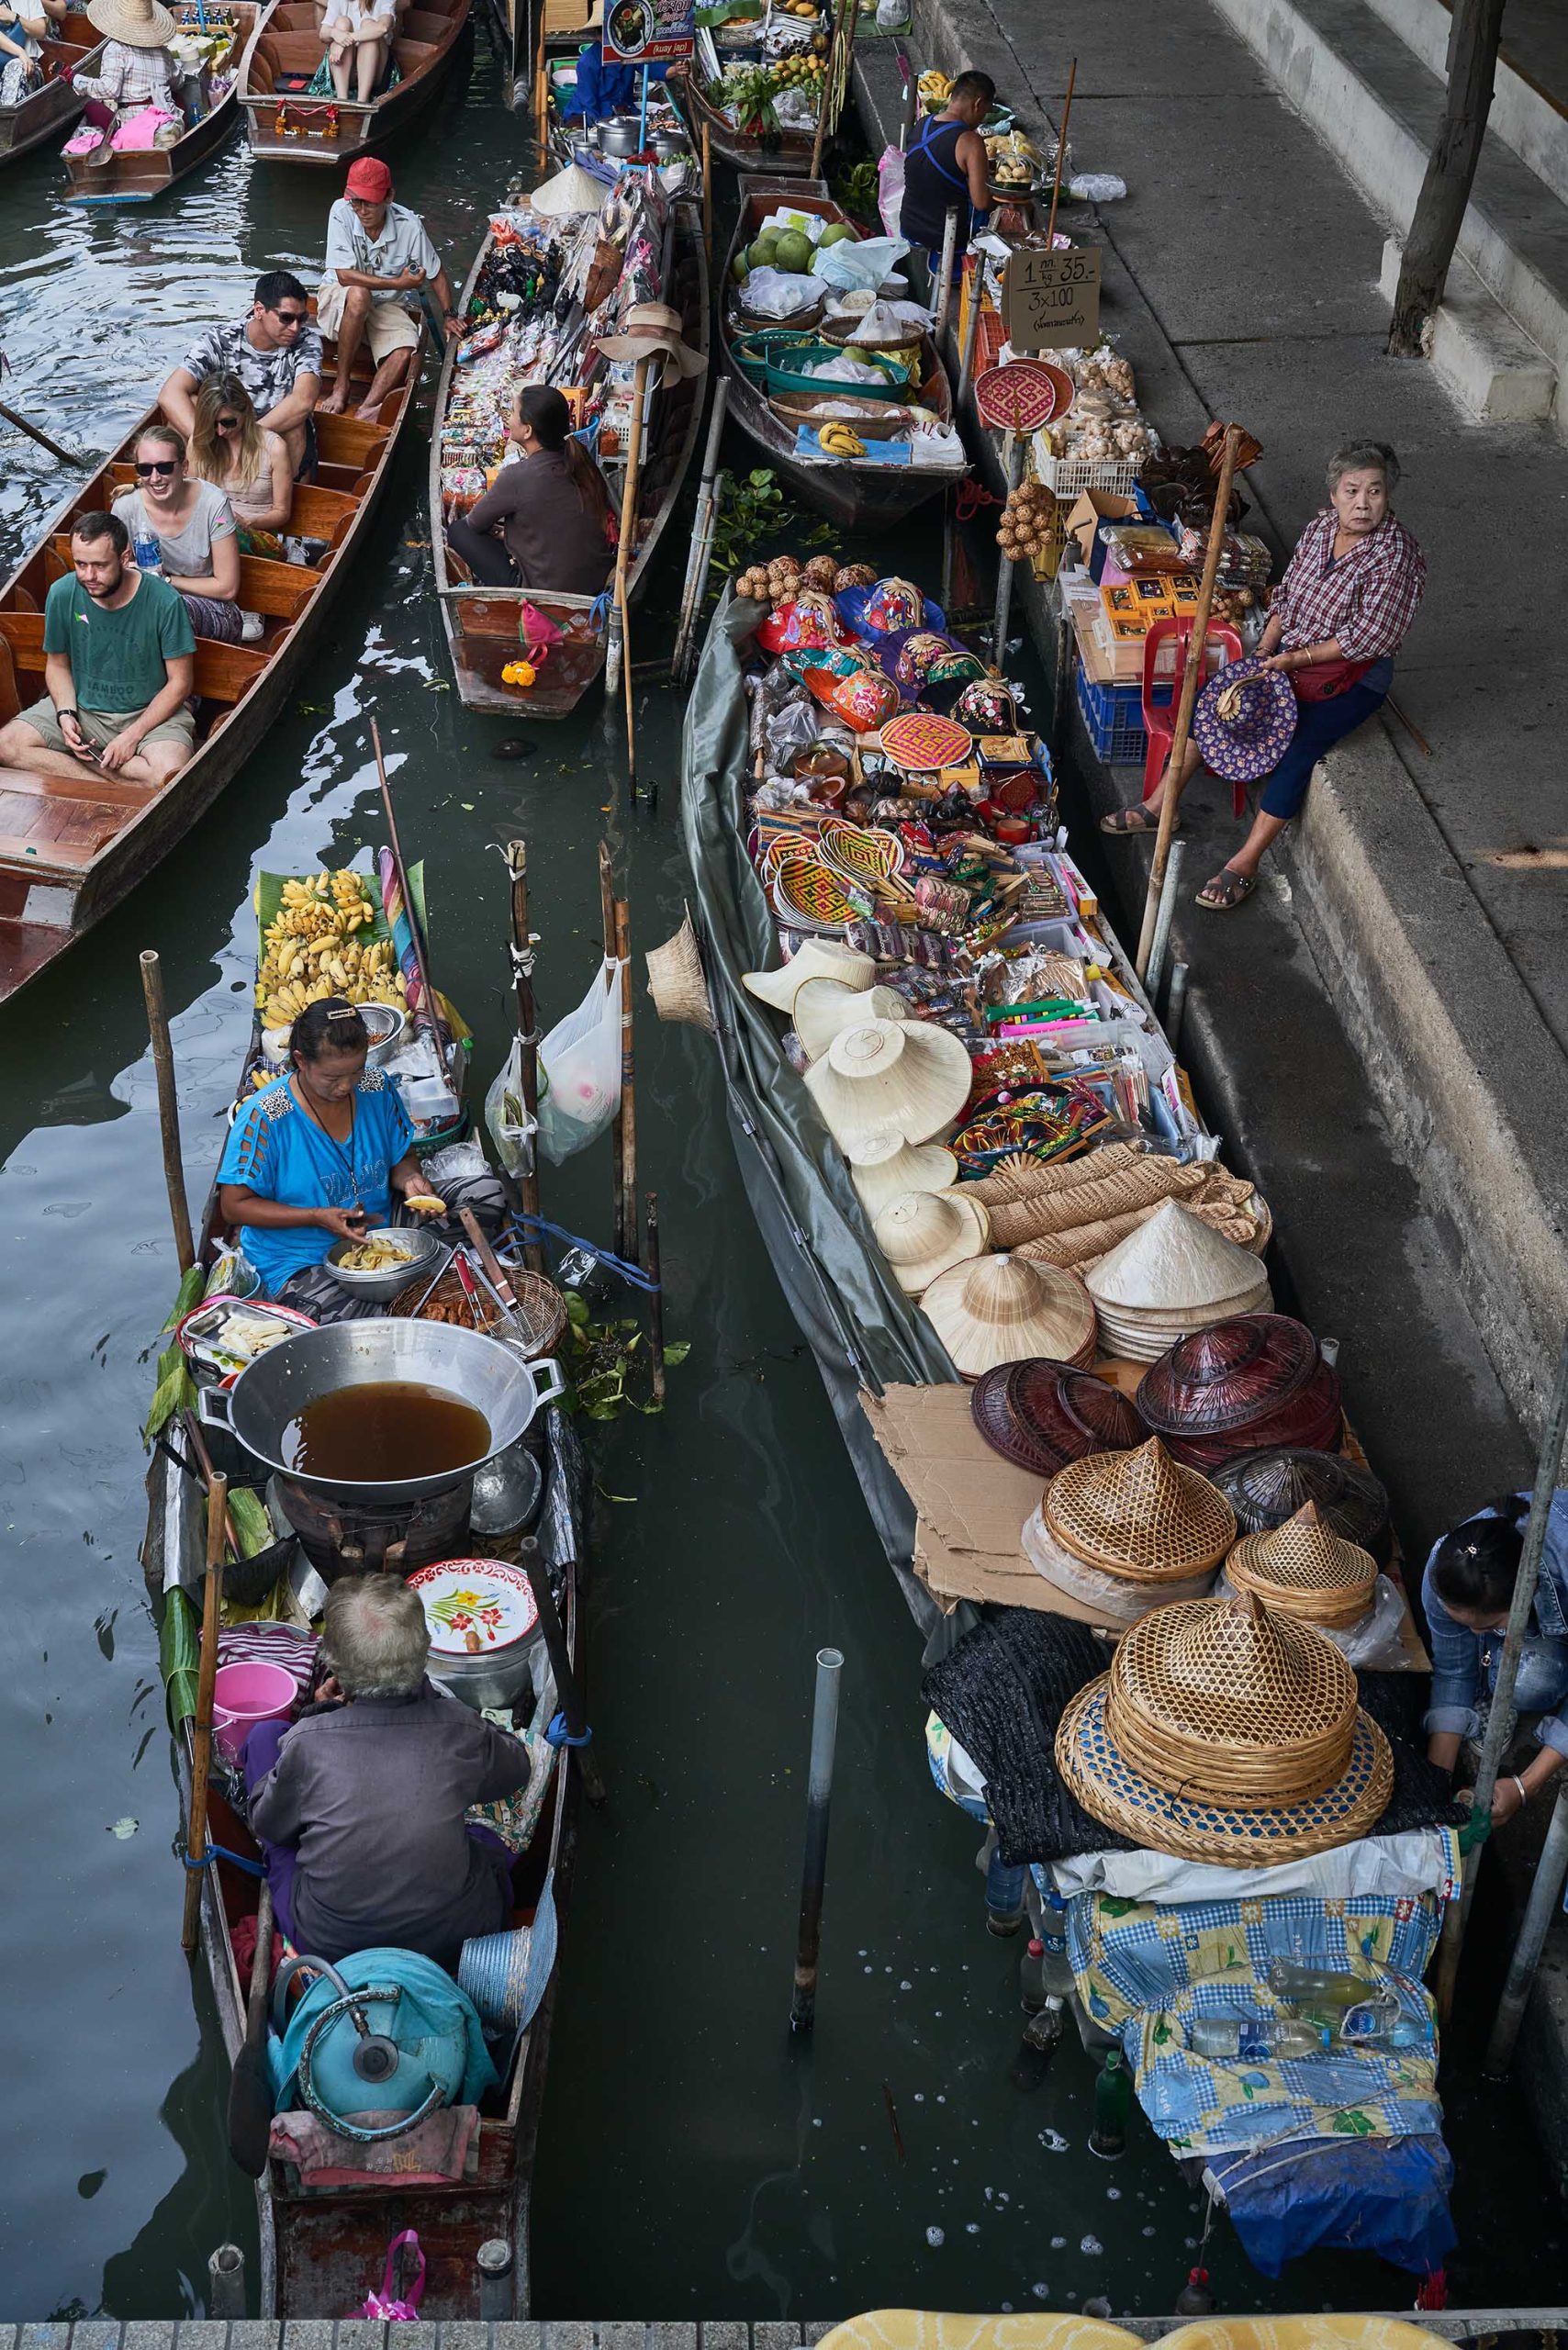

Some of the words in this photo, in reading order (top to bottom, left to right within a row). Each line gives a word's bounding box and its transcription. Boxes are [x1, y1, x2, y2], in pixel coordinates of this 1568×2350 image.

[653, 44, 672, 55] (kuay
[673, 42, 688, 53] jap)
[1025, 261, 1036, 284] 1
[1060, 256, 1095, 282] 35.-
